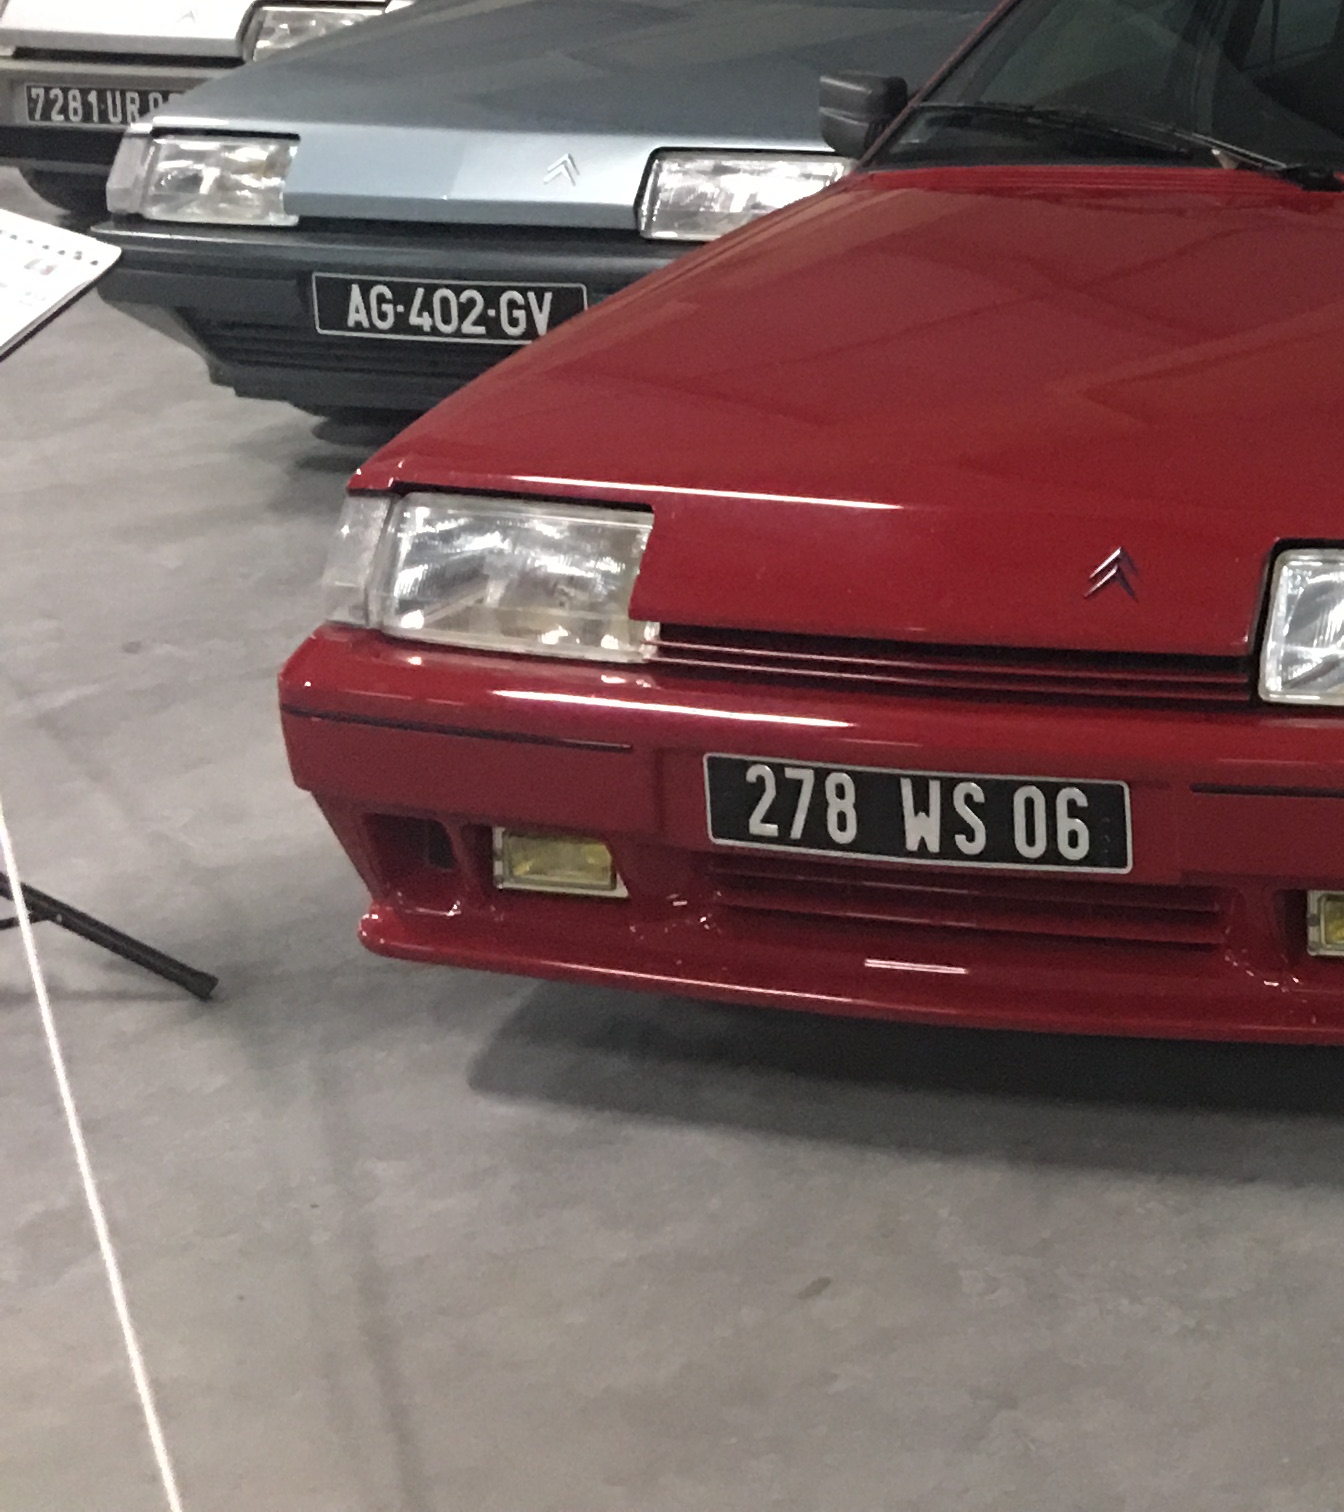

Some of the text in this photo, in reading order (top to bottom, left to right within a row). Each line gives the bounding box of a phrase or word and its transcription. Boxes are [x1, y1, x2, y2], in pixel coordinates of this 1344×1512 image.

[30, 87, 99, 124] 7281
[346, 283, 553, 337] AG-402-GV
[745, 763, 1090, 861] 278 WS 06
